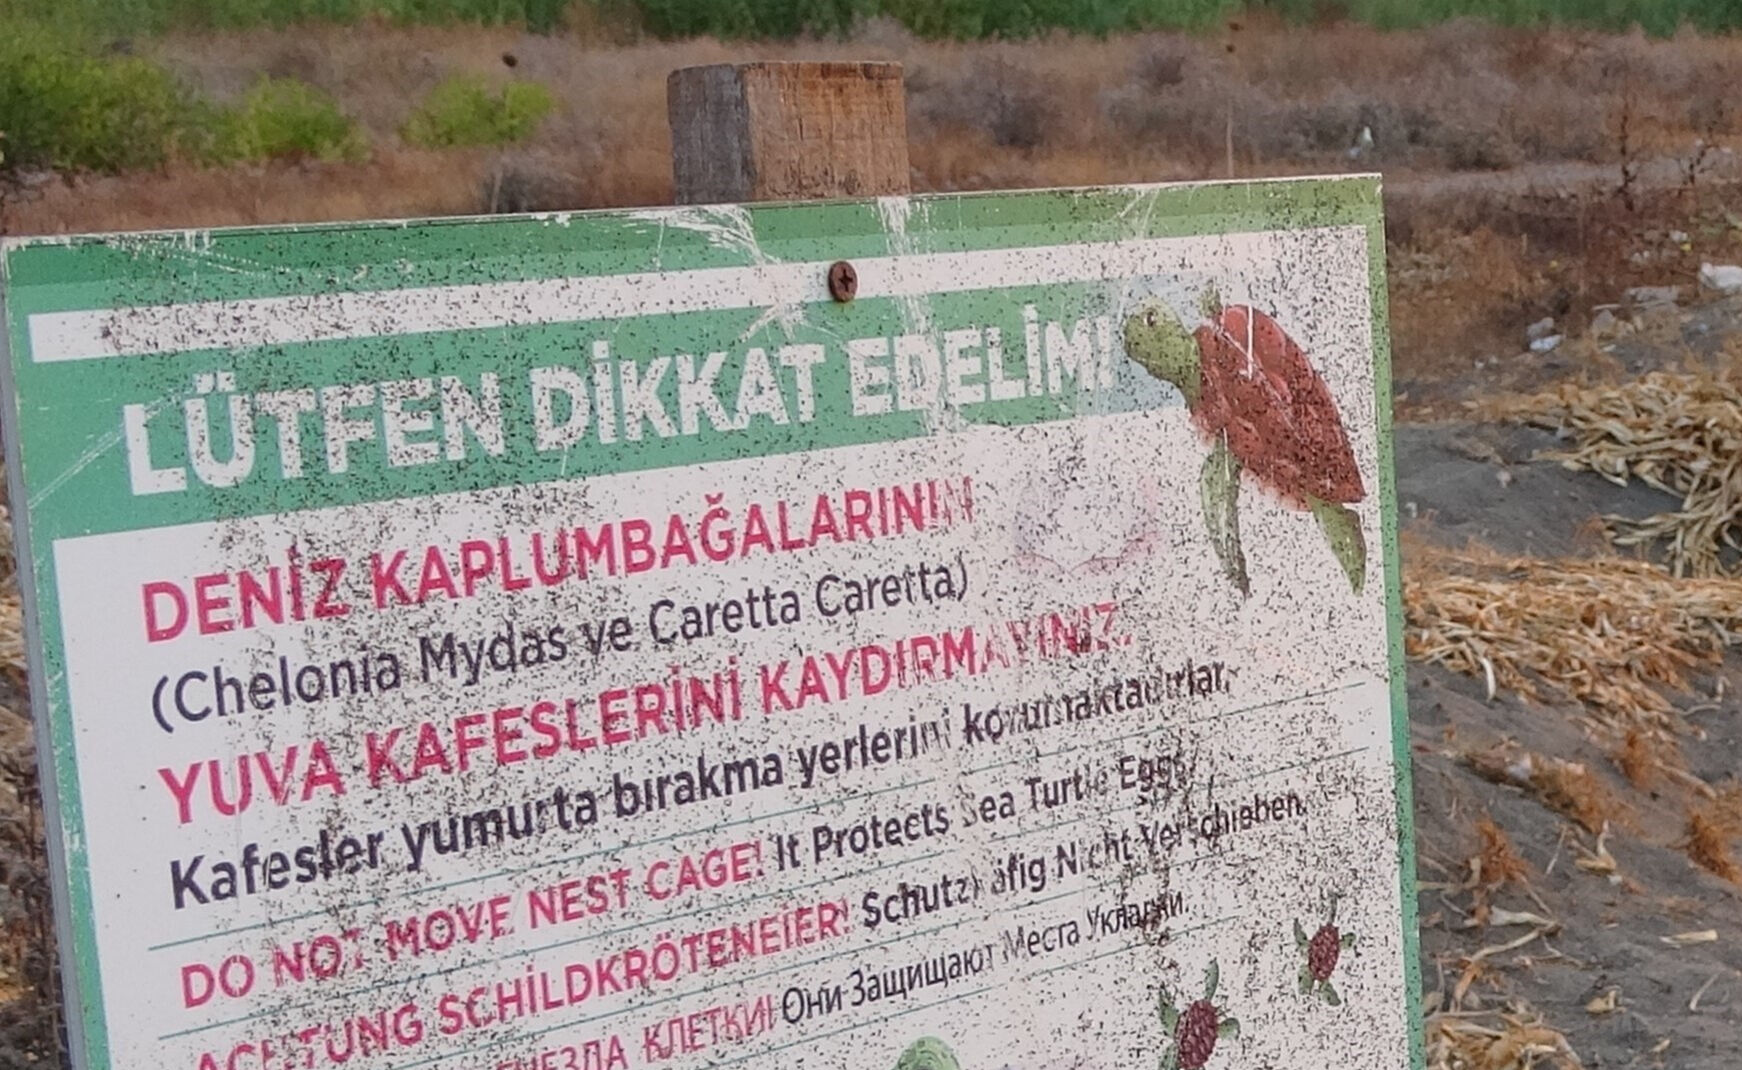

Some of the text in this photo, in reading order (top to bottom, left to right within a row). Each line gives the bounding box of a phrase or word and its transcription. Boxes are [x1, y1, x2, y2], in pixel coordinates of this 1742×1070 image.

[122, 302, 1114, 496] LÜTFEN DİKKAT EDELİM!
[142, 474, 974, 643] DENİZ KAPLUMBAĞALARININ
[151, 554, 969, 734] (Chelonia Mydas ve Caretta Caretta)
[158, 740, 346, 825] YUVA
[365, 654, 742, 789] KAFESLERİNİ
[170, 829, 385, 910] Kafesler
[402, 788, 599, 873] yumurta
[613, 754, 783, 820] bırakma
[798, 706, 952, 789] yerlerini
[181, 954, 255, 1009] DO
[272, 927, 365, 988] NOT
[385, 896, 514, 962] MOVE
[527, 868, 630, 929] NEST
[647, 840, 763, 903] CAGE!
[776, 832, 800, 873] It
[812, 800, 950, 866] Protects
[961, 790, 1016, 828] Sea
[782, 983, 843, 1025] Они
[850, 942, 994, 1006] Защищают
[1001, 919, 1080, 965] Места
